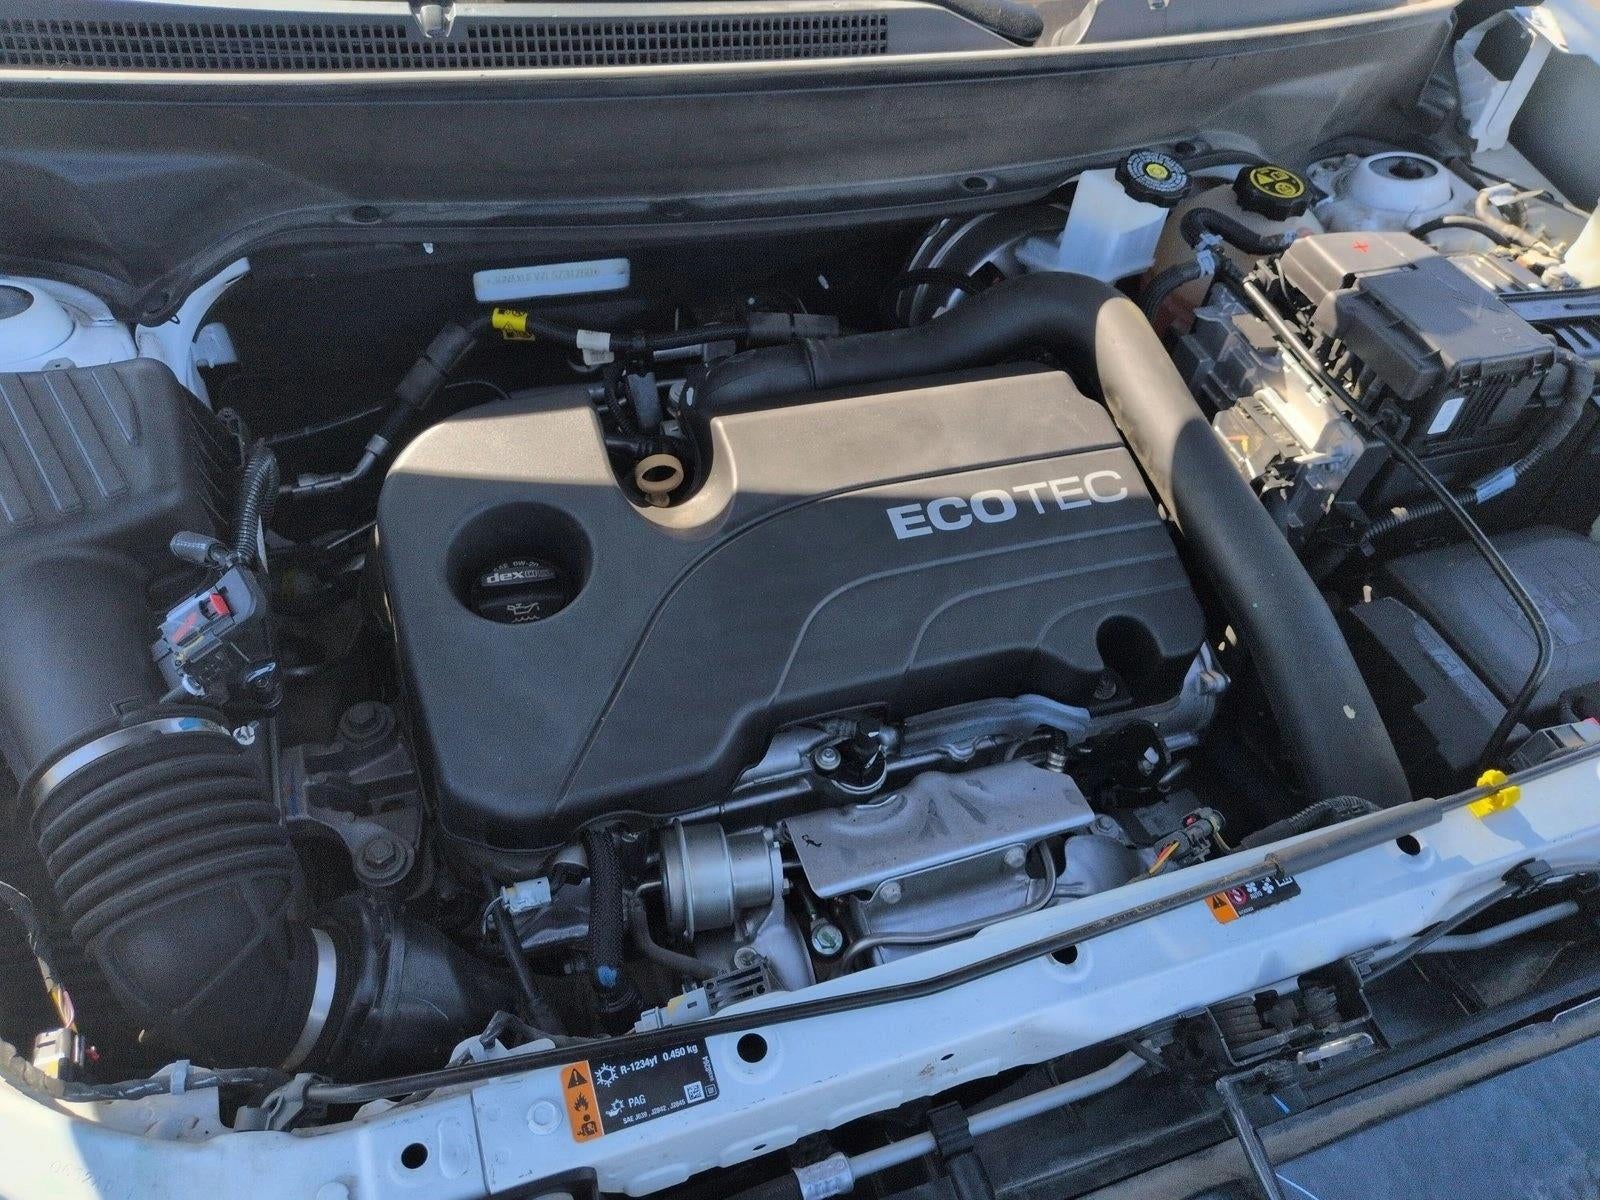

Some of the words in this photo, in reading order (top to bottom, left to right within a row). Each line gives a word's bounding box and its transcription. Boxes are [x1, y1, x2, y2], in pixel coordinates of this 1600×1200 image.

[887, 470, 1128, 540] ECOTEC
[620, 1055, 658, 1075] R-1234yf
[662, 1047, 685, 1061] 0.450
[687, 1044, 698, 1054] kg
[628, 1094, 647, 1108] PAG
[623, 1116, 634, 1124] SAE
